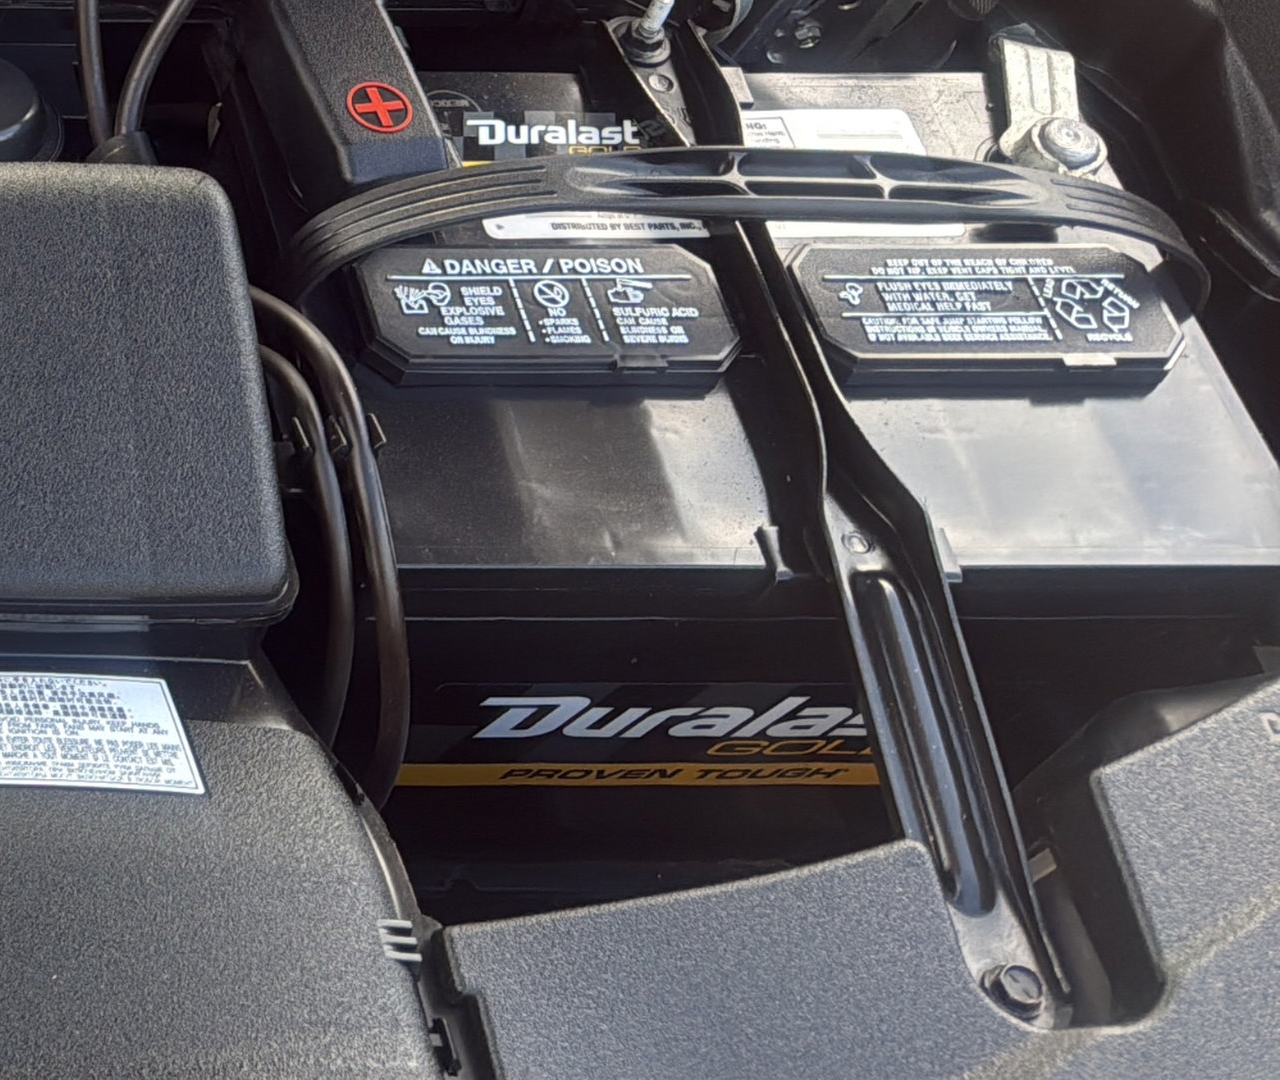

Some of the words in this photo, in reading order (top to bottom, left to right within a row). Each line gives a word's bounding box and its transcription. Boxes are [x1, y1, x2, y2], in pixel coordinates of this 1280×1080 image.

[466, 119, 640, 146] Duralast
[551, 222, 608, 231] DISTRIBUTED
[609, 222, 622, 230] BY
[623, 222, 646, 230] BEST
[647, 222, 679, 232] PARTS,
[443, 258, 538, 274] DANGER
[559, 258, 645, 274] POISON
[876, 281, 912, 291] FLUSH
[912, 281, 941, 291] EYES
[941, 281, 1013, 291] IMMEDIATELY
[460, 286, 503, 297] SHIELD
[881, 292, 911, 301] WITH
[954, 291, 977, 301] GET
[463, 297, 496, 306] EYES
[887, 302, 935, 312] MEDICAL
[935, 302, 963, 311] HELP
[964, 301, 991, 311] FAST
[440, 307, 505, 317] EXPLOSIVE
[548, 307, 567, 317] NO
[612, 307, 670, 317] SULFURIC
[672, 307, 699, 317] ACID
[444, 317, 485, 326] GASES
[616, 318, 637, 326] CAN
[639, 318, 668, 326] CAUSE
[418, 327, 437, 335] CAN
[438, 327, 467, 336] CAUSE
[469, 327, 517, 336] BLINDNESS
[620, 326, 668, 335] BLINDNESS
[670, 326, 685, 335] OR
[450, 336, 464, 345] OR
[465, 336, 496, 345] INJURY
[623, 335, 657, 344] SEVERE
[706, 740, 874, 757] GOL
[499, 767, 684, 781] PROVEN
[695, 767, 842, 781] TOUGH
